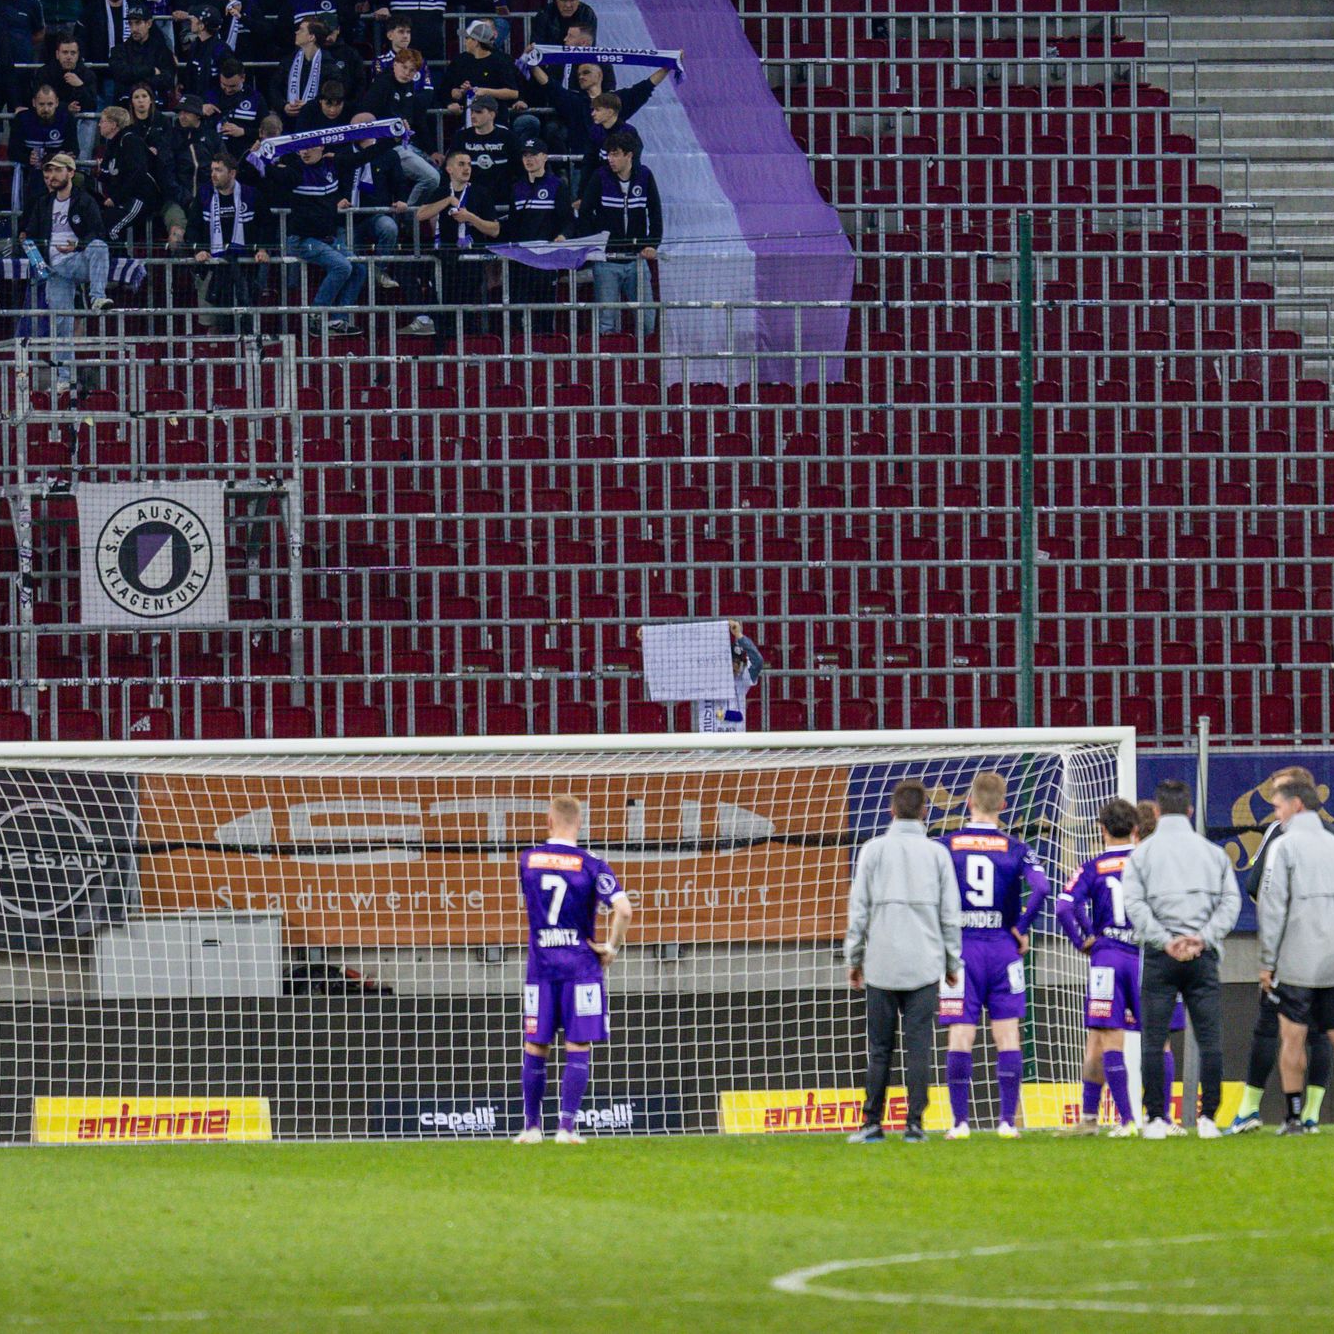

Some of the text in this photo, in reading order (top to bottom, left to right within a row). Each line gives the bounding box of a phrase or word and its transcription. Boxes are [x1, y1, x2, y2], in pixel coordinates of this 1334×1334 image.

[596, 54, 624, 63] 1995
[320, 133, 345, 145] 1995
[105, 505, 205, 554] S.K. AUSTRIA
[104, 565, 205, 611] KLAGENFURT
[216, 883, 485, 912] Stadtwerke
[540, 874, 568, 926] 7
[965, 854, 995, 907] 9
[1105, 875, 1127, 928] 1
[77, 1102, 231, 1141] antenne
[419, 1107, 497, 1132] capelli
